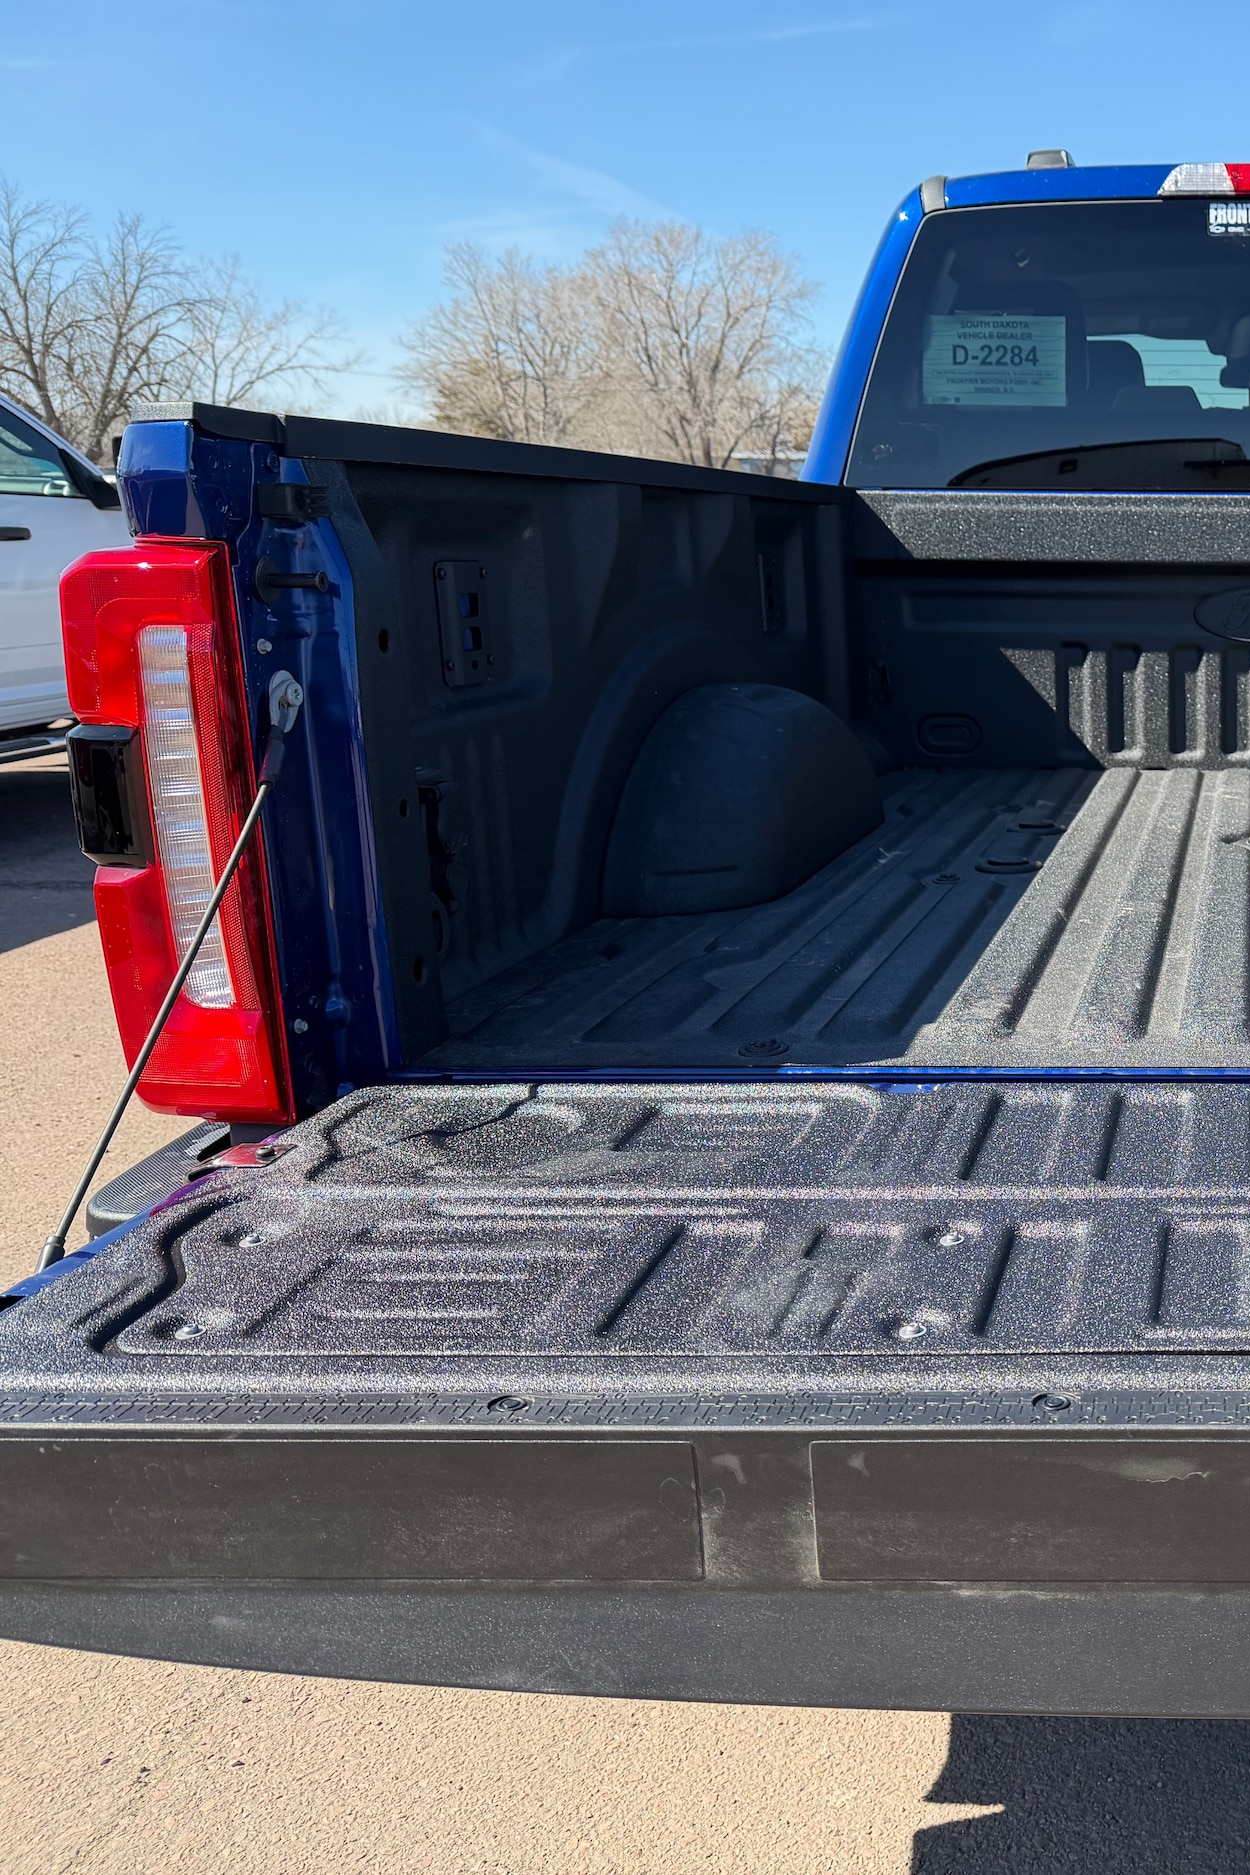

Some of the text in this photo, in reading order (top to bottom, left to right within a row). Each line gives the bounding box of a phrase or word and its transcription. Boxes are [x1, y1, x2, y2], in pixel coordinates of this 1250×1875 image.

[960, 320, 1030, 329] SOUTH DAKOTA
[957, 331, 1033, 341] VEHICLE DEALER
[952, 344, 1040, 367] D-2284
